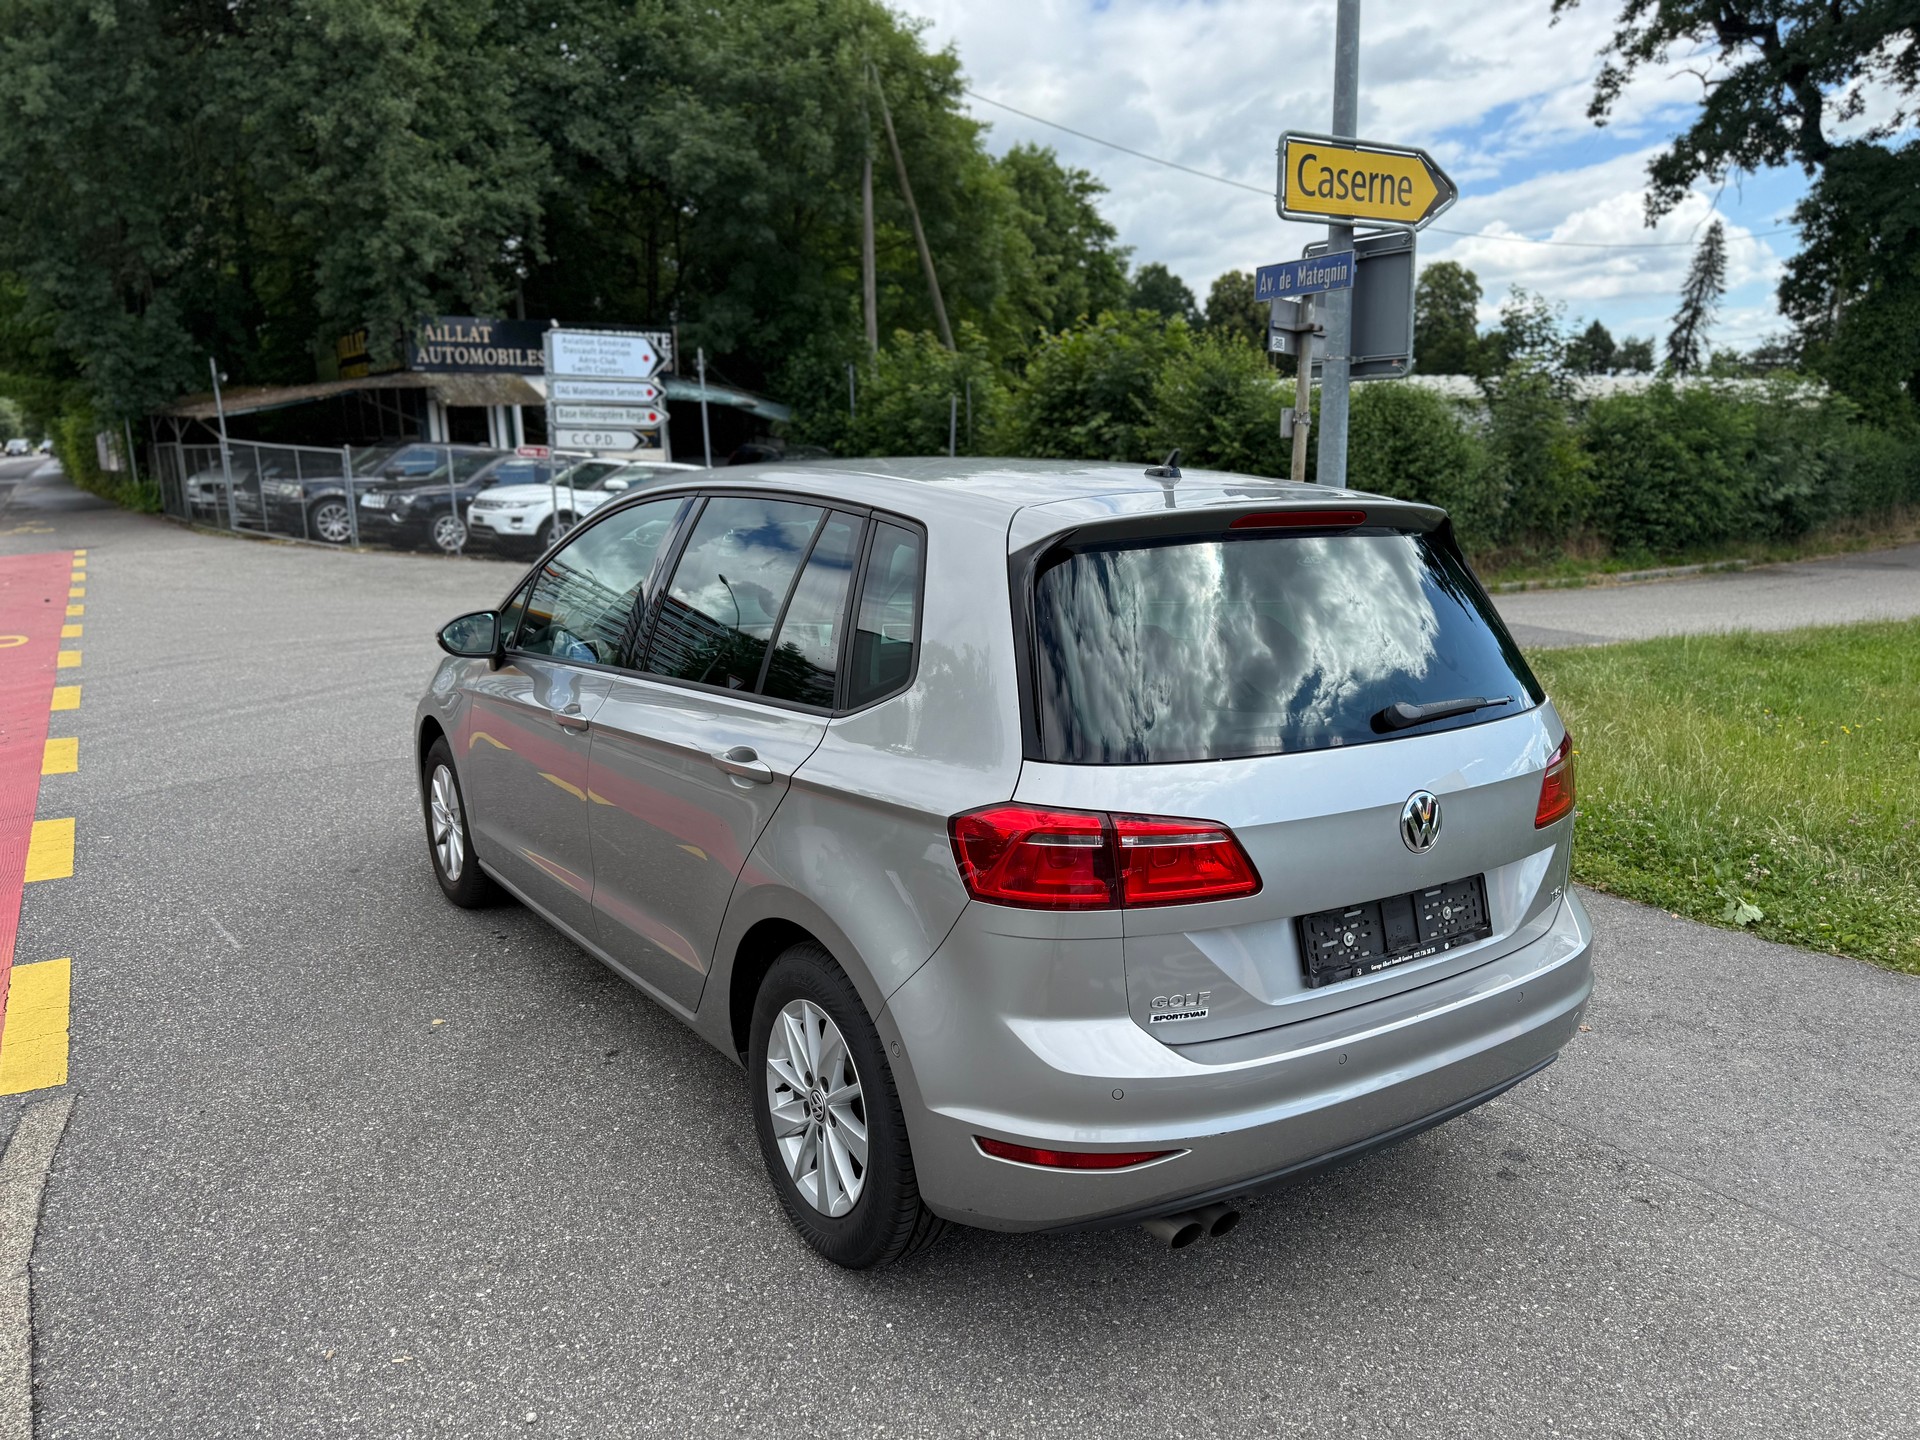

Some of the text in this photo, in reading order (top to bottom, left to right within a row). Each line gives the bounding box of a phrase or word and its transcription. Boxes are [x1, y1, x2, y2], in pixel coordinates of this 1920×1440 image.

[1297, 153, 1412, 206] Caserne
[1260, 262, 1348, 293] Av. de Mategnin
[416, 324, 492, 343] AILLAT
[561, 337, 631, 348] Aviation Générale
[416, 346, 546, 367] AUTOMOBILES
[562, 345, 631, 356] Dassault Aviation
[557, 386, 644, 397] TAG Maintenance Services
[560, 408, 577, 418] Base
[626, 410, 645, 421] Rega
[1150, 991, 1211, 1008] GOLF
[1153, 1010, 1206, 1021] SPORTSVAN
